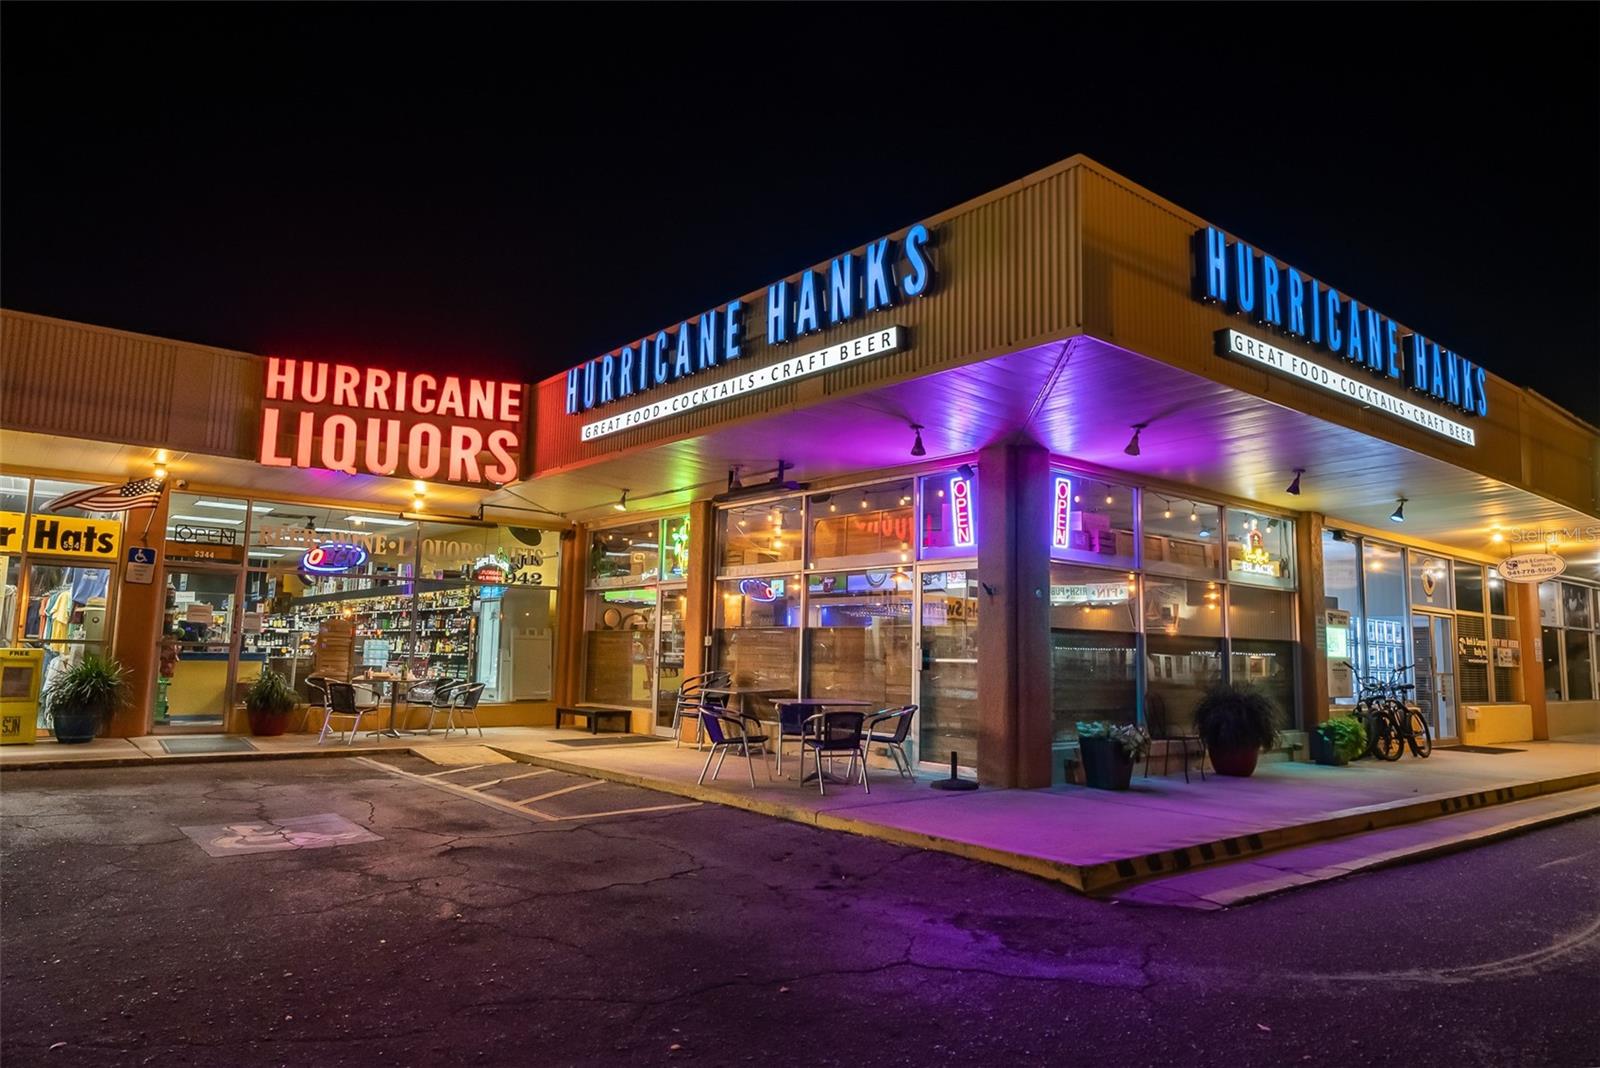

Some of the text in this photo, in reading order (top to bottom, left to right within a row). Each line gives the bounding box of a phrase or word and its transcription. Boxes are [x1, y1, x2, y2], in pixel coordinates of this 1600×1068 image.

[566, 223, 928, 415] HURRICANE HANKS
[1207, 226, 1487, 416] HURRICANE HANKS
[266, 357, 521, 422] HURRICANE
[584, 331, 892, 438] GREAT FOOD COCKTAILS CRAFT BEER
[1234, 335, 1473, 444] GREAT FOOD COCKTAILS CRAFT BEER
[261, 408, 519, 485] LIQUORS
[34, 520, 114, 554] Hats
[177, 525, 235, 544] OPEN
[954, 481, 969, 543] OPEN
[1056, 483, 1068, 544] OPEN
[194, 550, 215, 559] 5344
[399, 534, 483, 561] LQUORS
